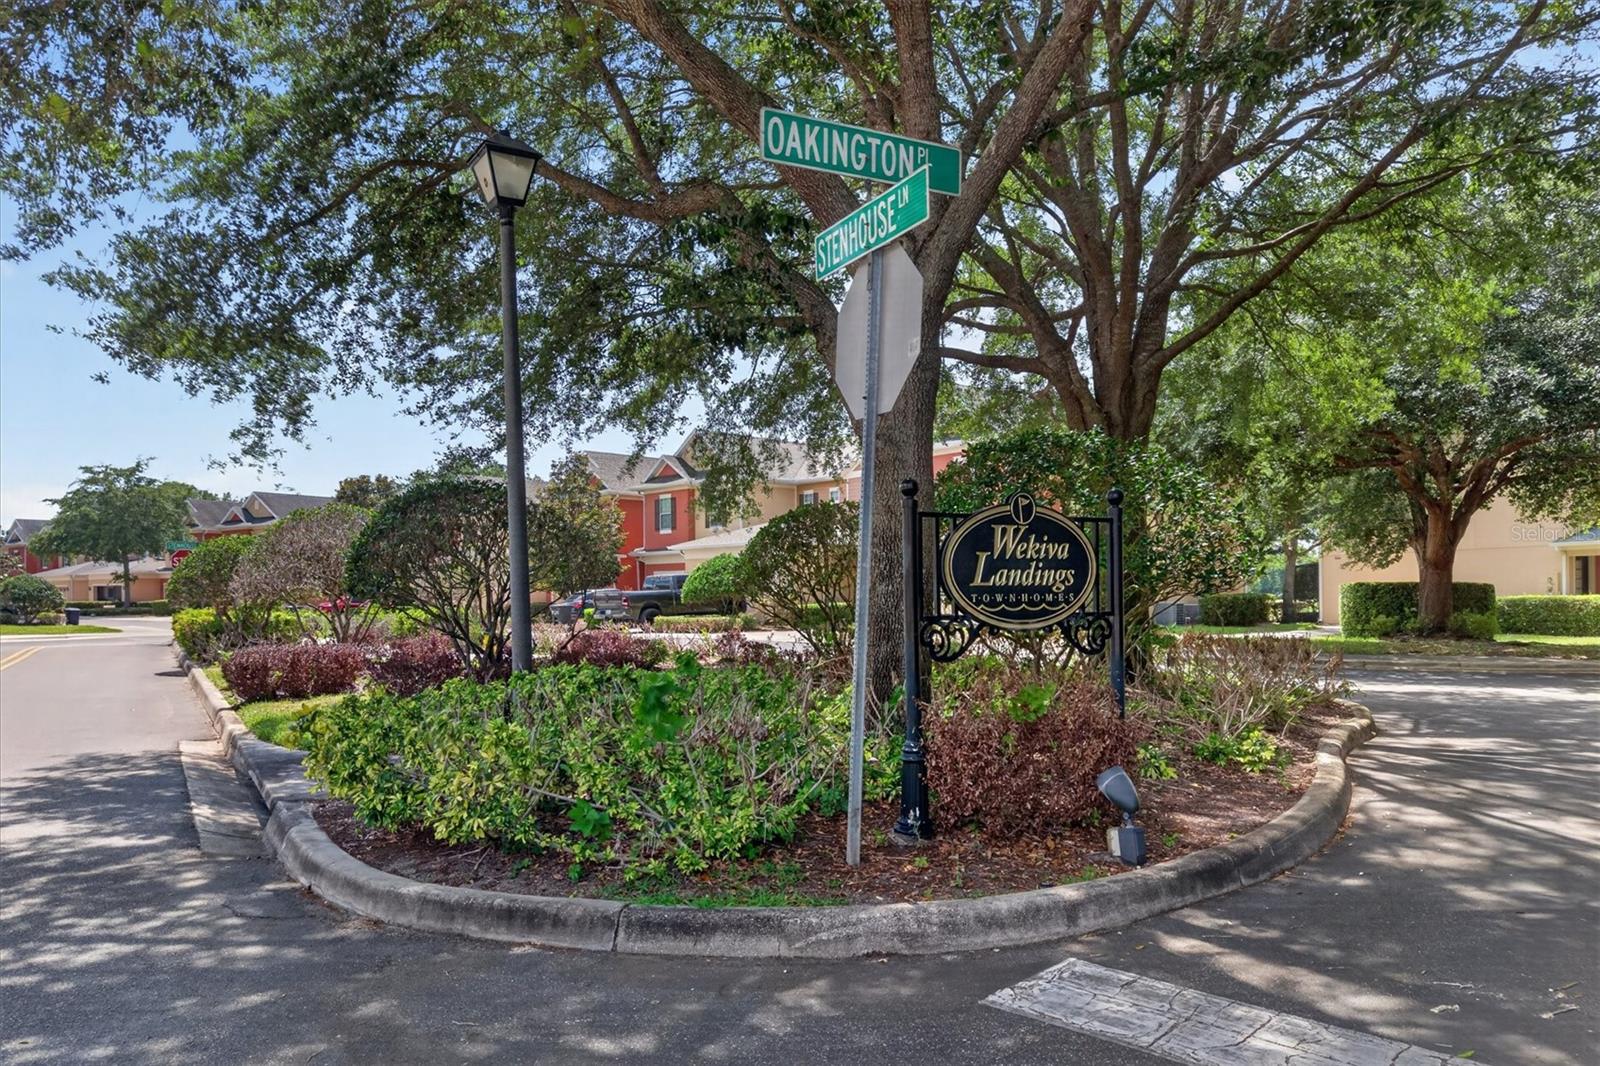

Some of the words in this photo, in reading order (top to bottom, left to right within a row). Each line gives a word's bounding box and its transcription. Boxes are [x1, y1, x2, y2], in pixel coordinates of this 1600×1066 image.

[766, 115, 914, 178] OAKINGTON
[817, 193, 897, 272] STENHOUSE
[897, 184, 909, 208] LN
[991, 524, 1069, 560] Wekiva
[969, 551, 1075, 593] Landings
